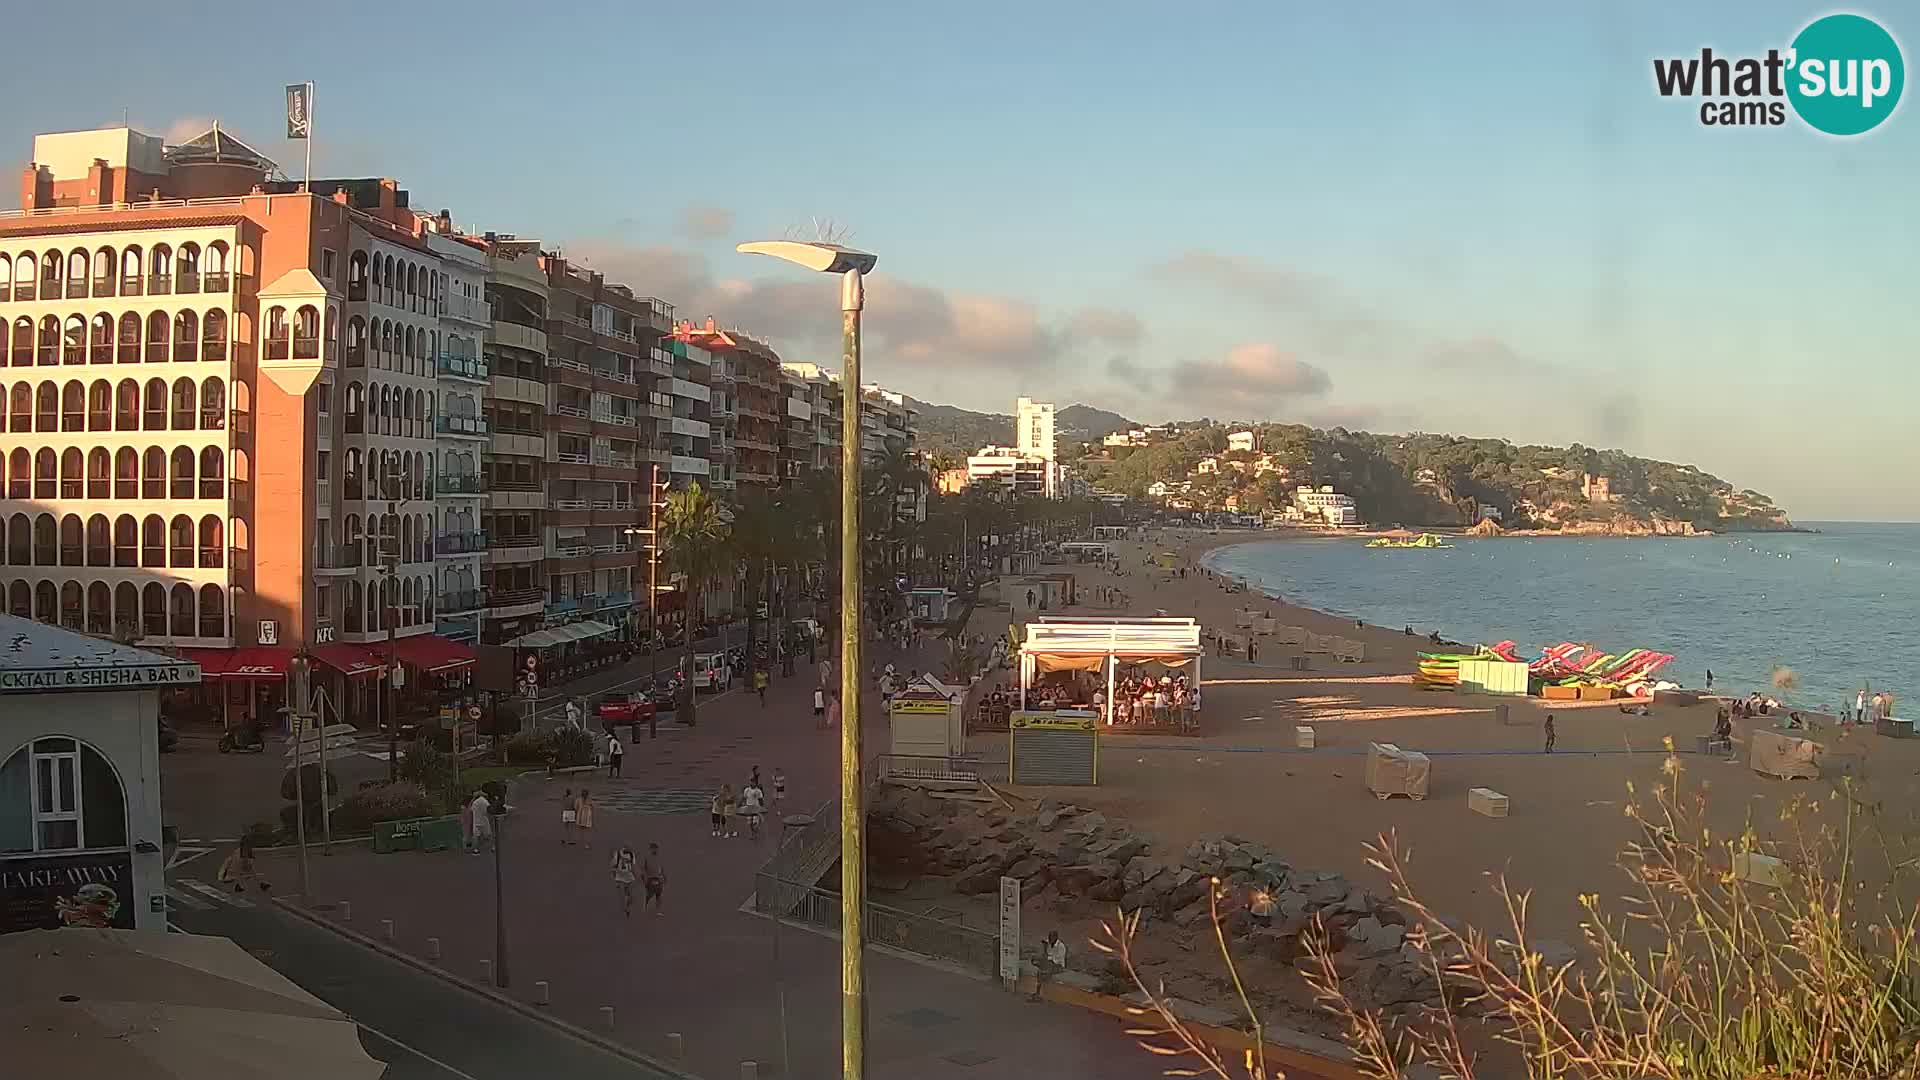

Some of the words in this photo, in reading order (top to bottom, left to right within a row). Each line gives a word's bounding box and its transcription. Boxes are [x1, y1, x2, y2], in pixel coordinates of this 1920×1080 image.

[315, 627, 335, 644] KFC
[65, 671, 77, 685] &
[80, 668, 142, 685] SHISHA
[149, 667, 180, 682] BAR
[237, 665, 274, 673] KFC
